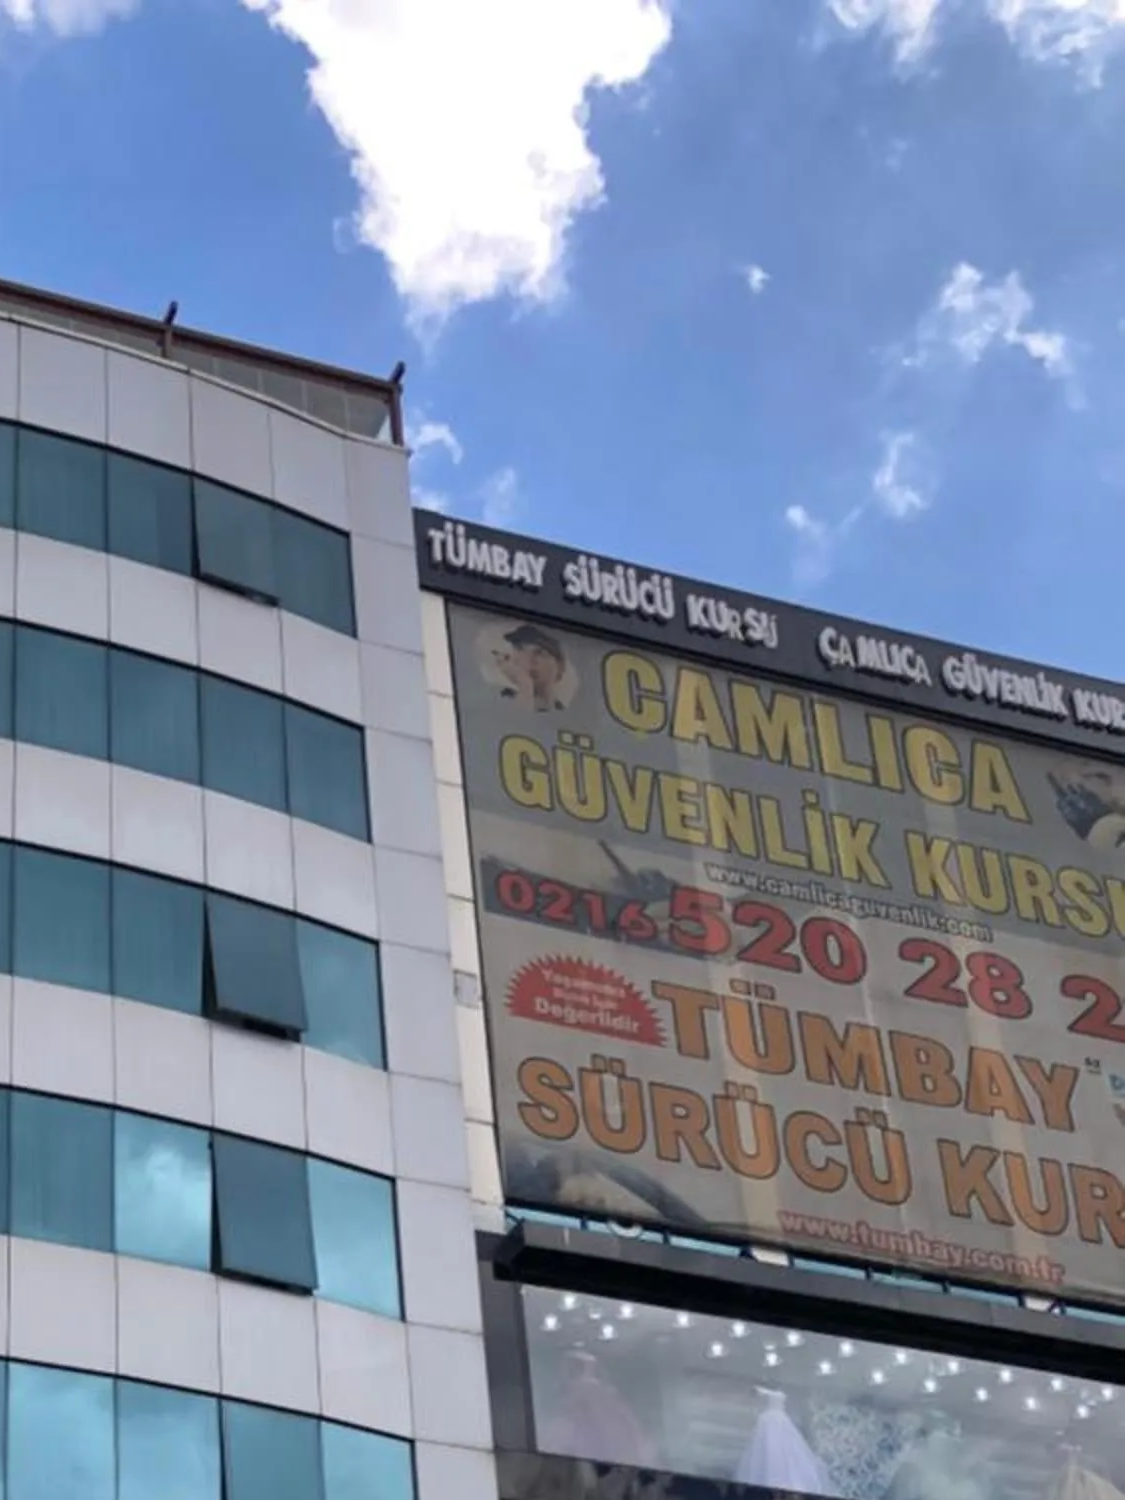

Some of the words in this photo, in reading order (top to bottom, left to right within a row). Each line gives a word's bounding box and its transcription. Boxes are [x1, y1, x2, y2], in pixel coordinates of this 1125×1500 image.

[429, 521, 546, 587] TÜMBAY
[563, 554, 674, 619] SÜRÜCÜ
[942, 652, 1069, 716] GÜVENLİK
[499, 733, 891, 889] GÜVENLİK
[496, 870, 657, 943] 0216
[667, 886, 867, 986] 520
[898, 938, 1032, 1020] 28
[518, 1054, 912, 1206] SÜRÜCÜ
[651, 978, 1080, 1133] TÜMBAY
